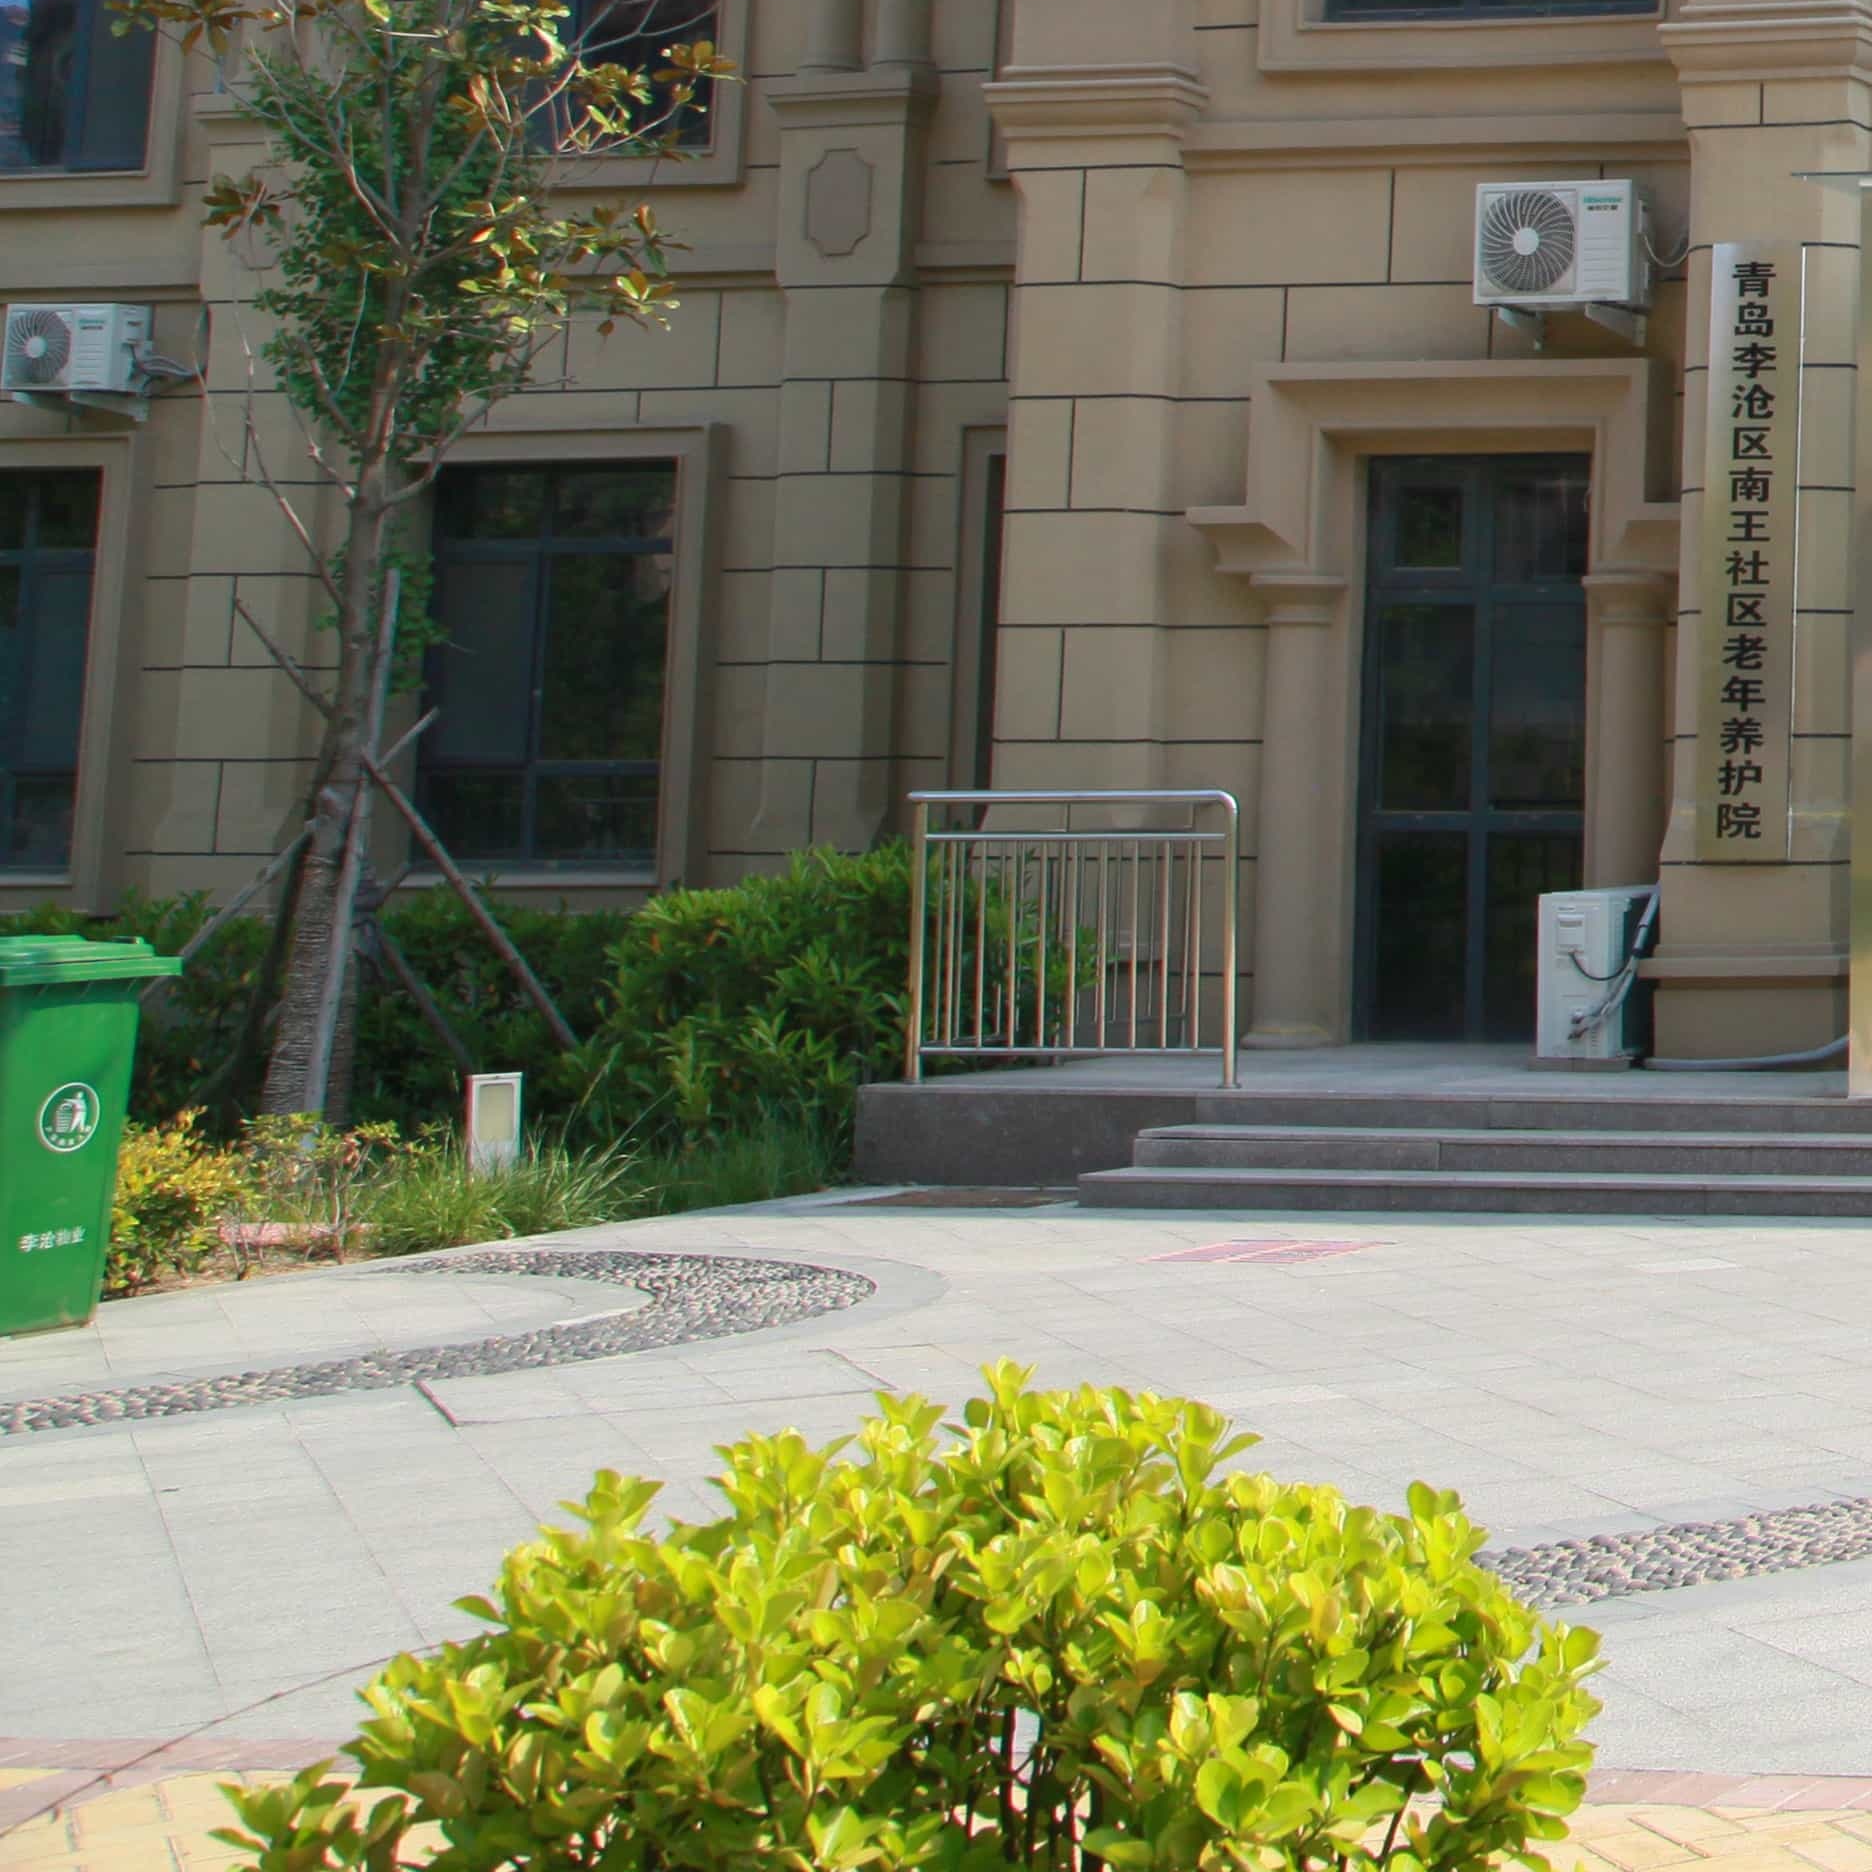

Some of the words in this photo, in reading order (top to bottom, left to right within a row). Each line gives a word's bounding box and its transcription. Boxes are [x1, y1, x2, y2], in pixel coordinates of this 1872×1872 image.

[1715, 260, 1778, 840] 青岛李沧区南王社区老年养护院
